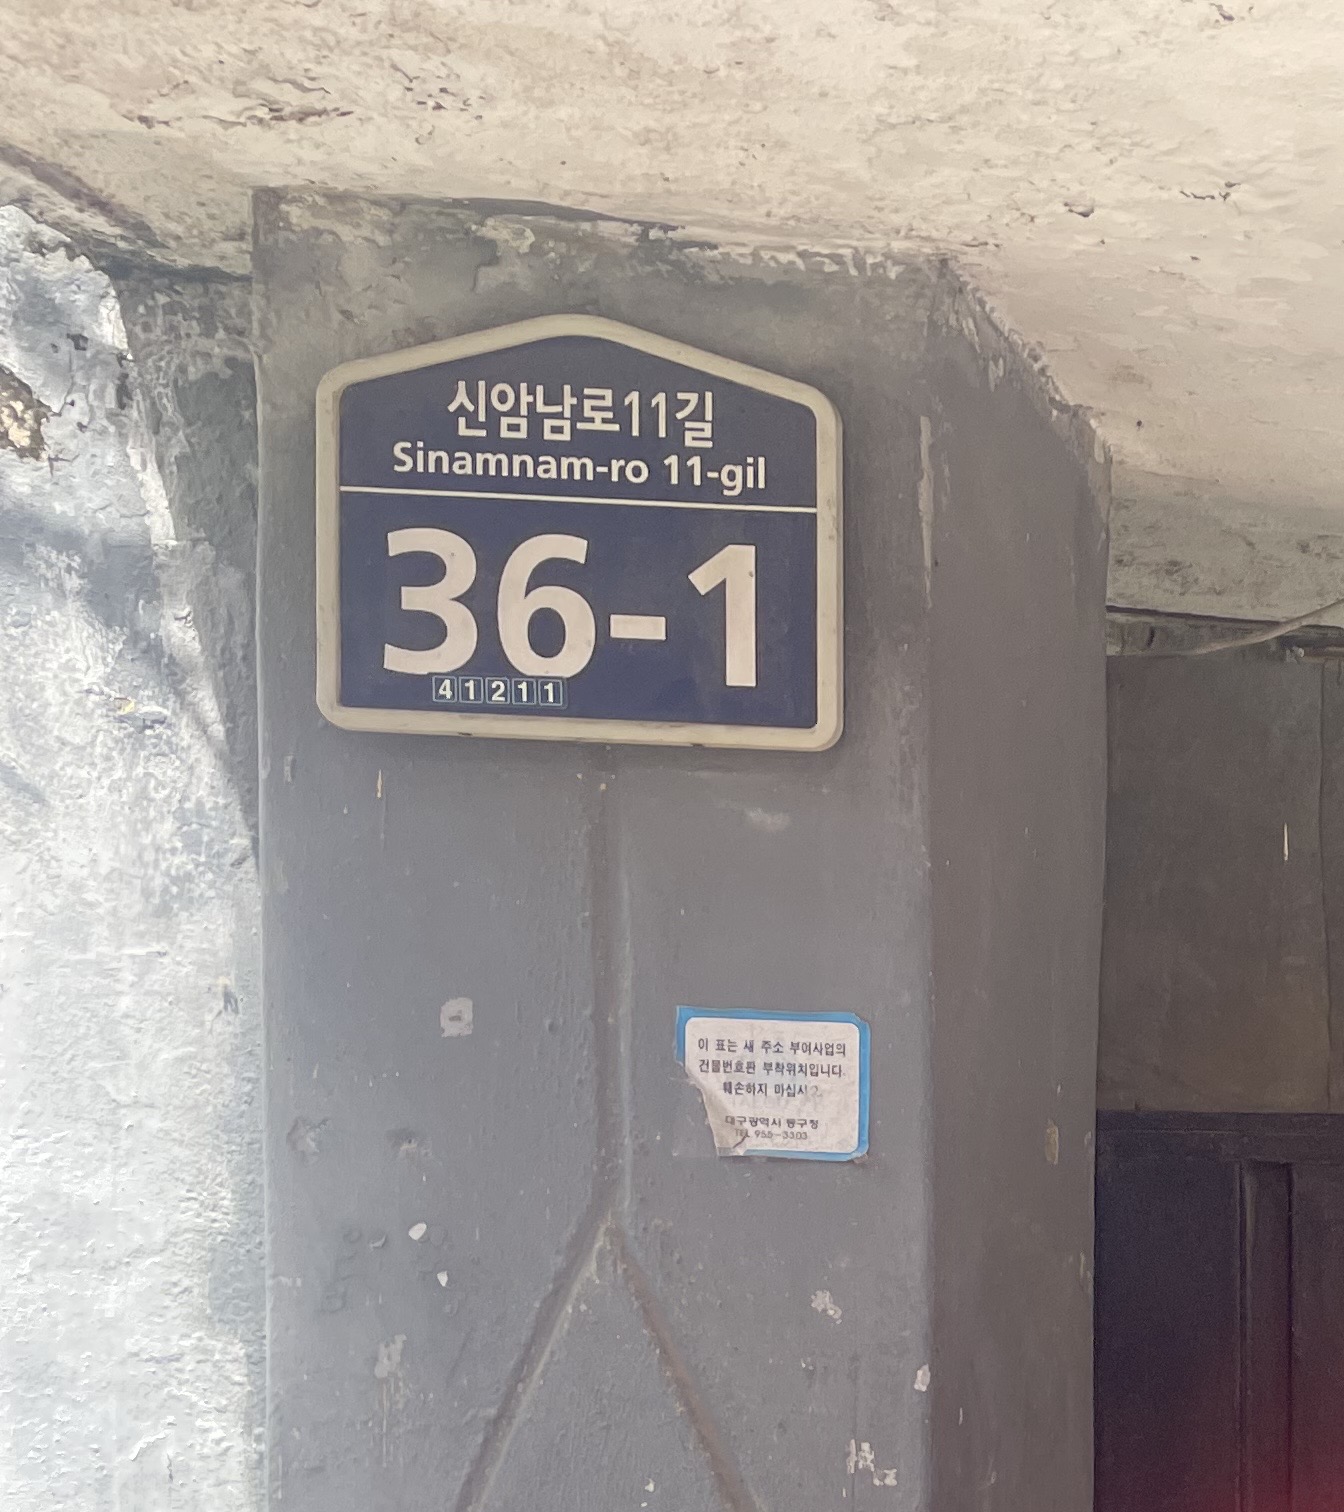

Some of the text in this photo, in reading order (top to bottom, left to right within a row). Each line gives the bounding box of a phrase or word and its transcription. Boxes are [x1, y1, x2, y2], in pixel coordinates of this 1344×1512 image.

[447, 379, 714, 448] 신암남로11길
[393, 441, 767, 496] Sinamnam-ro 11-gil
[383, 527, 757, 688] 36-1
[435, 678, 562, 703] 41211
[698, 1037, 846, 1057] 이 표는 새 주소 부여사업의
[698, 1059, 756, 1075] 건물번호판
[724, 1115, 819, 1130] 대구광역시 동구청
